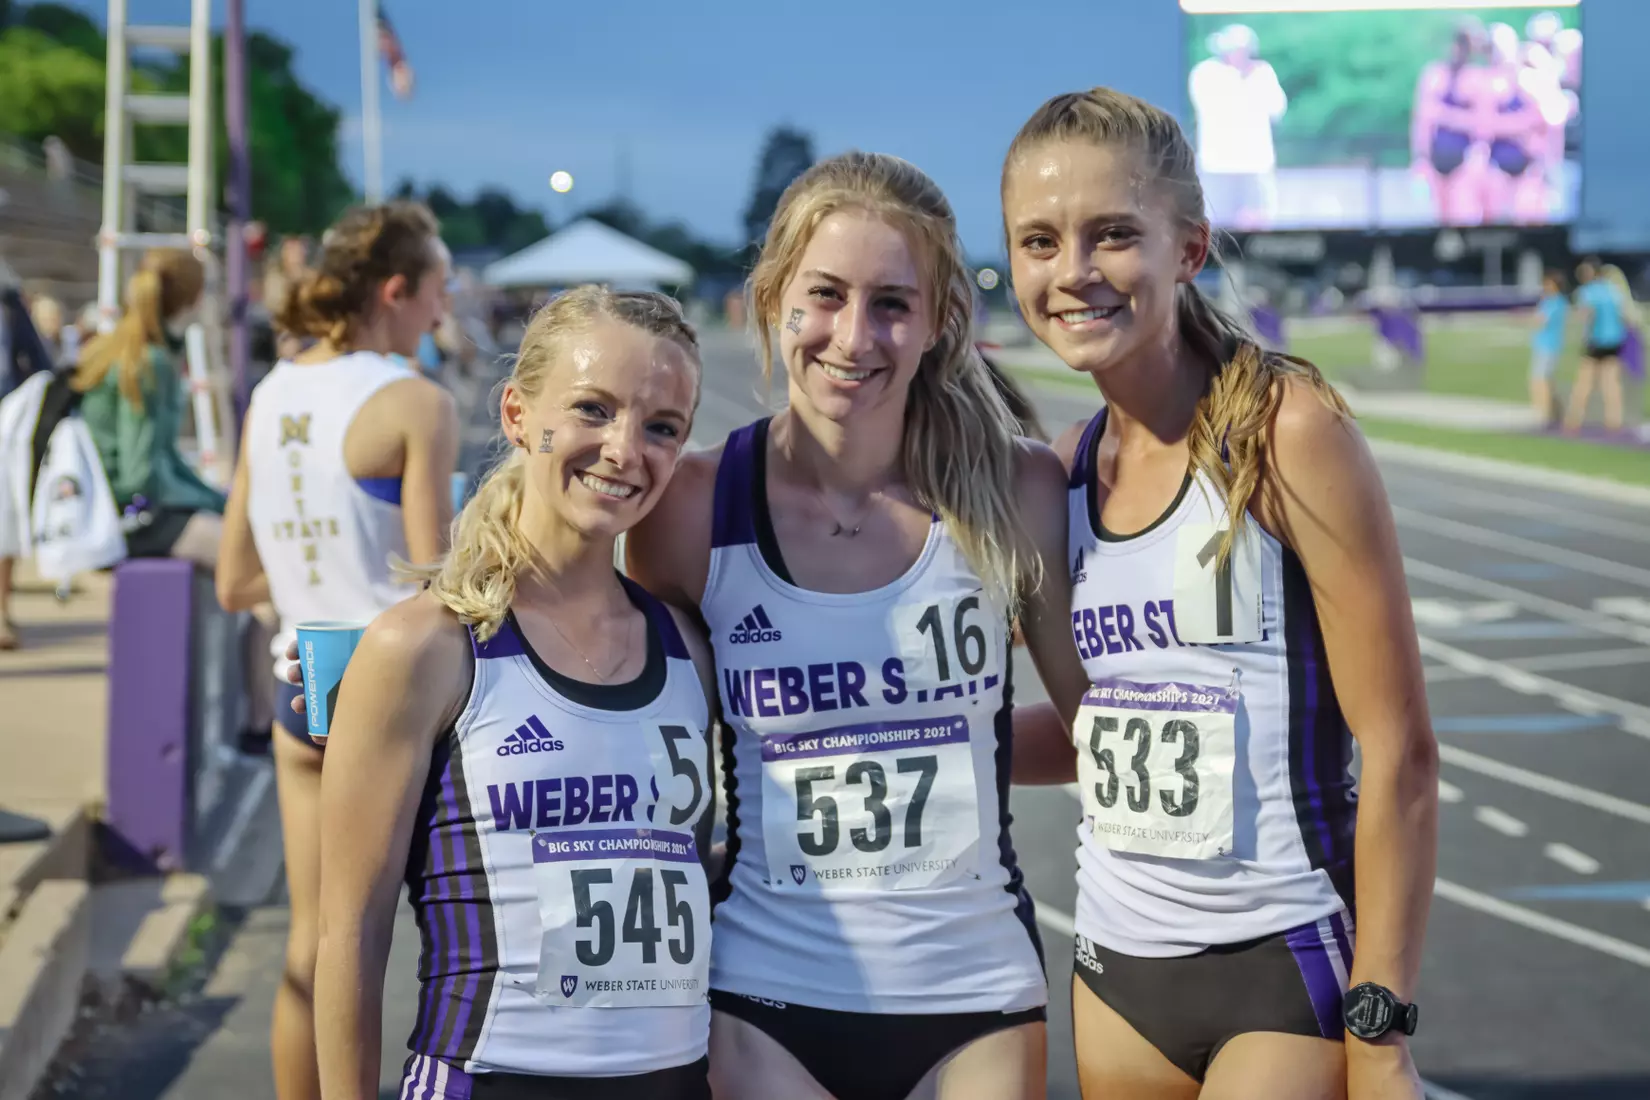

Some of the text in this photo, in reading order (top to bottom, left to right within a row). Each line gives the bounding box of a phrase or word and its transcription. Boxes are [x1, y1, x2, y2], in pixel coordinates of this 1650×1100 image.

[1196, 529, 1233, 636] 1
[729, 626, 782, 645] adidas
[916, 596, 987, 682] 16
[1072, 604, 1145, 660] EBER
[305, 640, 320, 728] POWERADE
[724, 661, 870, 718] WEBER
[496, 737, 564, 757] adidas
[774, 725, 952, 754] BIG SKY CHAMPIONSHIPS 2021
[1089, 716, 1200, 817] 533
[487, 774, 639, 832] WEBER
[658, 725, 703, 826] 5
[795, 755, 939, 856] 537
[548, 838, 688, 855] BIG SKY CHAMPIONSHIPS 2021
[1149, 829, 1210, 844] UNIVERSITY
[813, 858, 959, 880] WEBER STATE UNIVERSITY
[570, 867, 695, 966] 545
[585, 978, 699, 992] WEBER STATE UNIVERSITY
